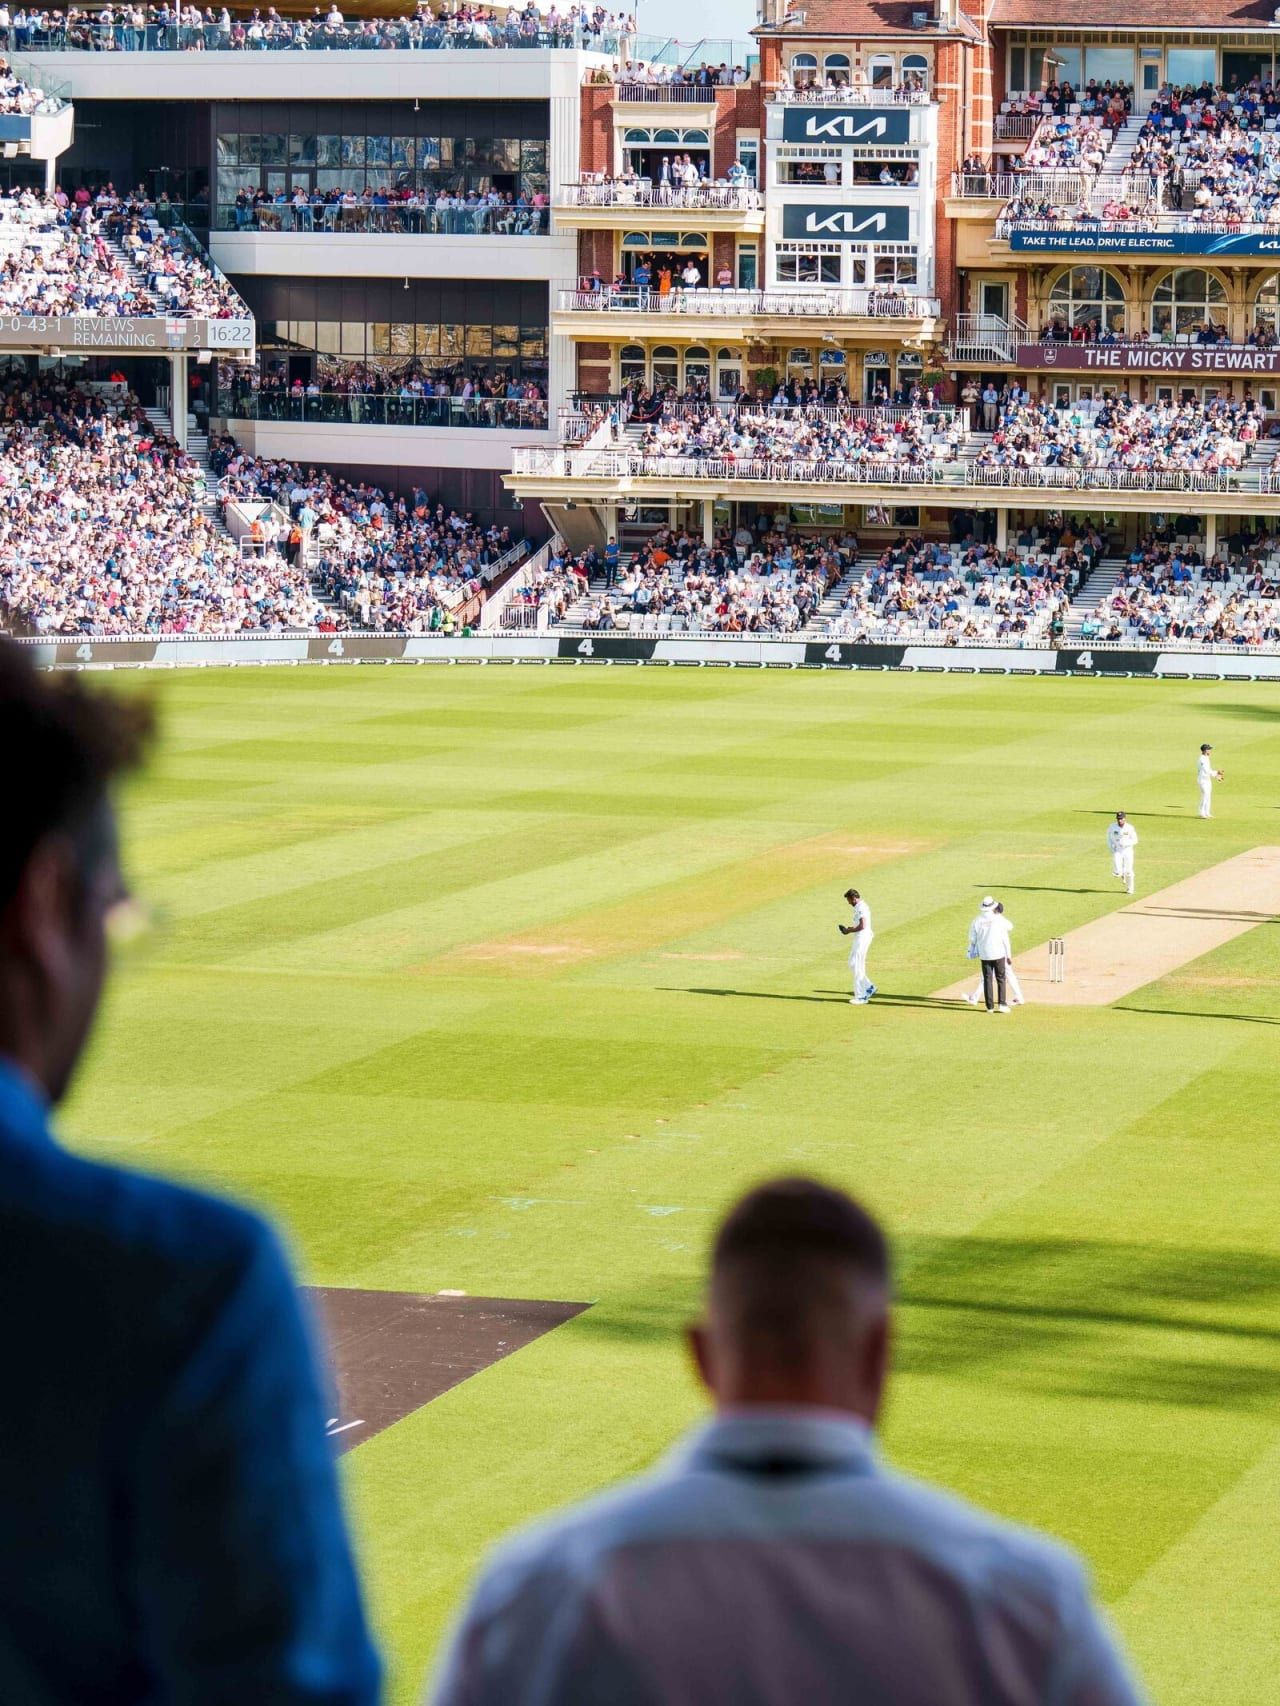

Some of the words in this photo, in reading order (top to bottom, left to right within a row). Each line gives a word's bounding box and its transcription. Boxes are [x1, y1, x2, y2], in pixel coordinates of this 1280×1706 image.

[806, 115, 887, 137] KIA
[806, 212, 887, 232] KIA
[1022, 237, 1046, 246] TAKE
[1048, 237, 1067, 246] THE
[1069, 237, 1096, 246] LEAD.
[1098, 238, 1127, 247] DRIVE
[1128, 238, 1175, 248] ELECTRIC.
[73, 318, 135, 331] REVIEWS
[211, 326, 251, 341] 16:22
[74, 333, 156, 346] REMAINING
[193, 334, 201, 346] 2
[1085, 350, 1121, 366] THE
[1127, 351, 1186, 368] MICKY
[1191, 352, 1277, 369] STEWART
[76, 643, 93, 662] 4
[327, 639, 345, 657] 4
[577, 638, 595, 656] 4
[825, 644, 842, 662] 4
[1076, 652, 1094, 669] 4
